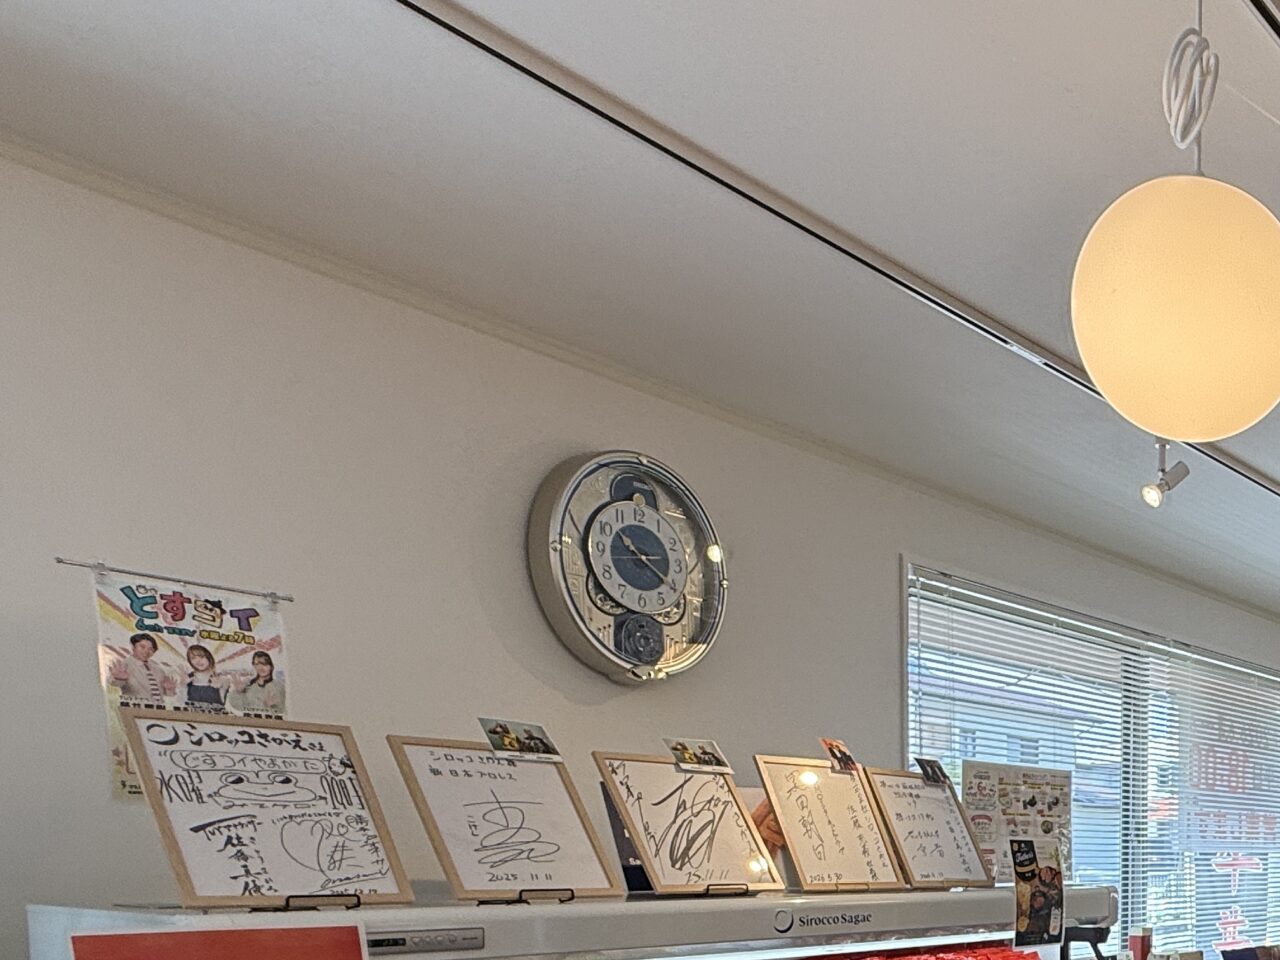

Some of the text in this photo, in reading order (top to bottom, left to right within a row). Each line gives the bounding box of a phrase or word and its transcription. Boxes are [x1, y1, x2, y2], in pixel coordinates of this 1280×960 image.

[615, 509, 624, 523] 11
[633, 508, 646, 523] 12
[600, 521, 612, 536] 10
[656, 519, 661, 533] 1
[596, 542, 605, 556] 9
[669, 537, 677, 551] 2
[602, 566, 612, 580] 8
[674, 559, 682, 573] 3
[618, 584, 627, 598] 7
[657, 591, 665, 605] 5
[638, 594, 646, 608] 6
[799, 913, 872, 927] Sirocco Sagae
